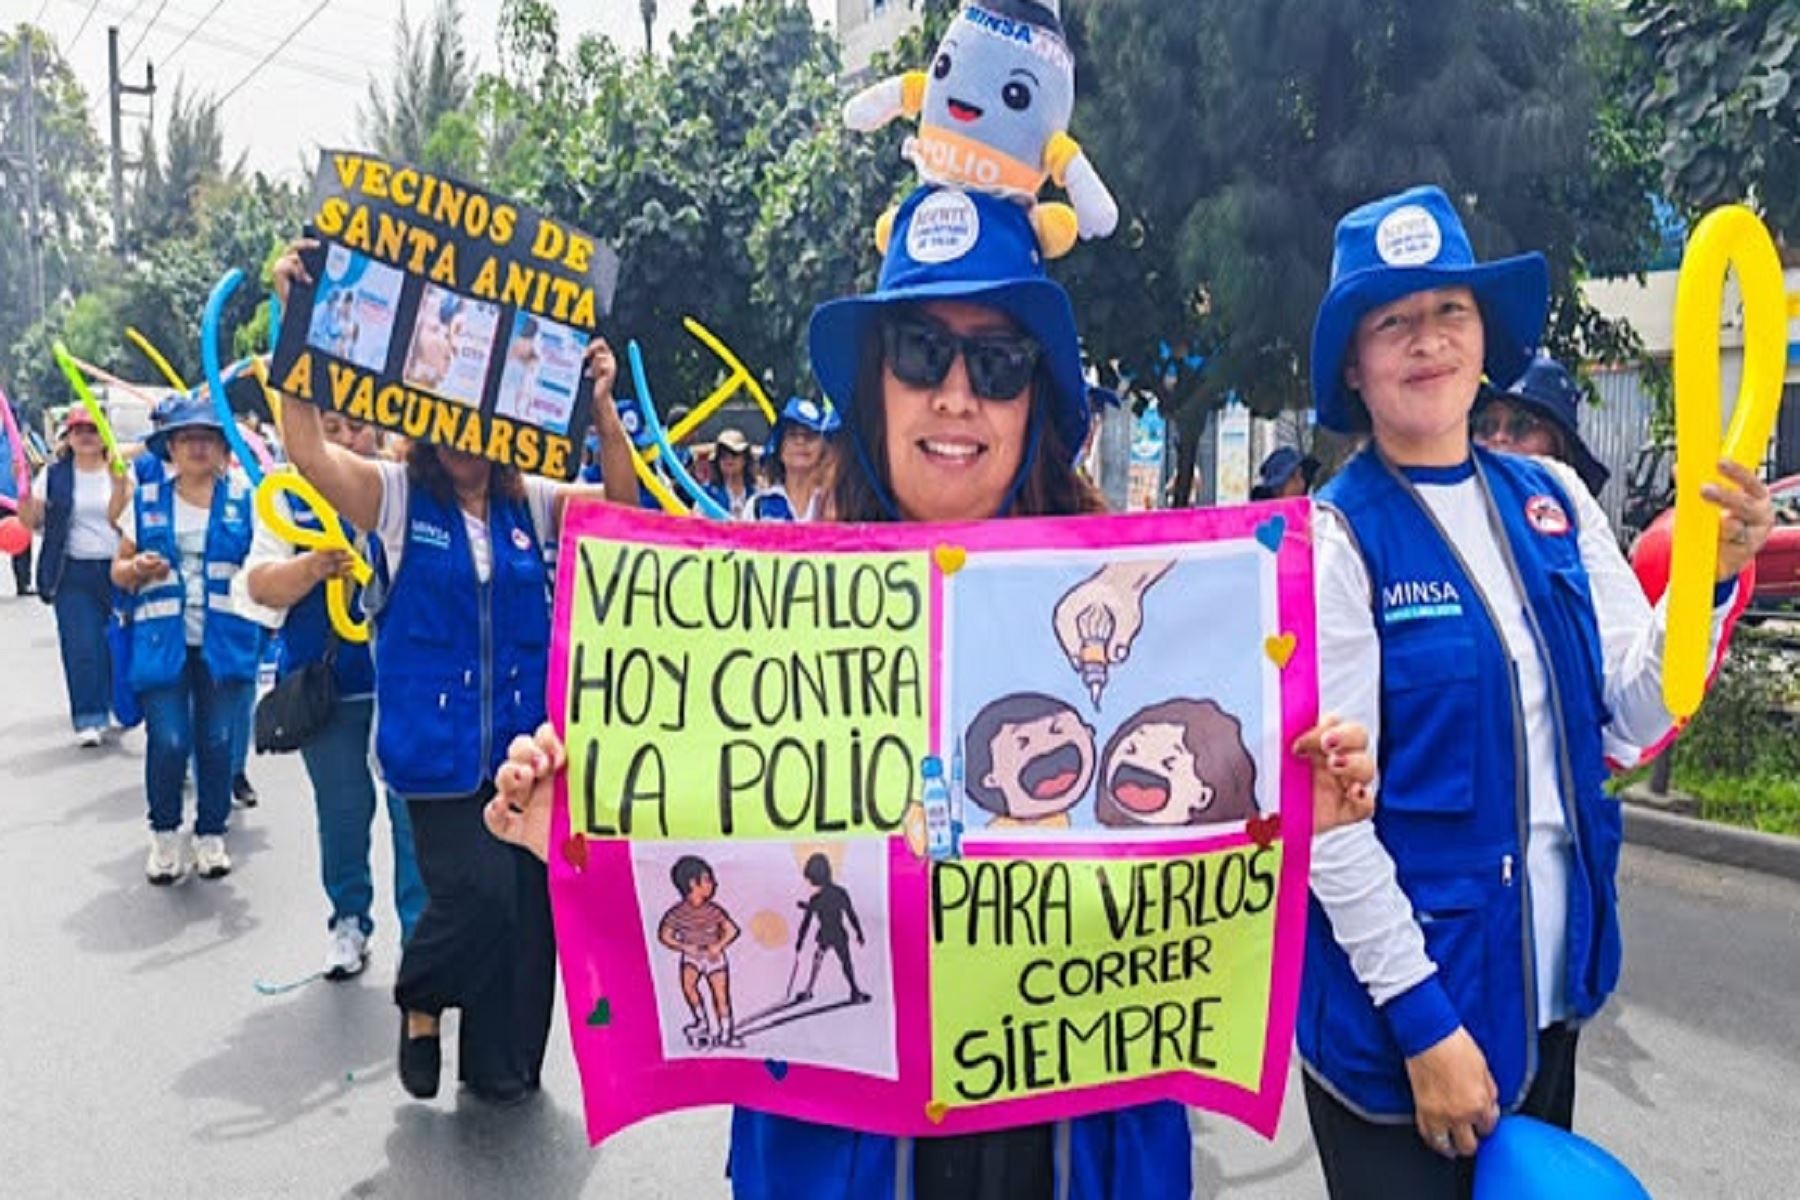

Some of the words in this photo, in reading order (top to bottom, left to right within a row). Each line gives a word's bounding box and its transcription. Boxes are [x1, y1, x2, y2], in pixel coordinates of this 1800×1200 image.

[963, 6, 1033, 45] MINSA
[334, 156, 517, 244] VECINOS
[531, 219, 596, 273] DE
[315, 197, 457, 285] SANTA
[472, 256, 597, 328] ANITA
[283, 352, 313, 398] A
[328, 363, 573, 479] VACUNARSE
[579, 541, 923, 632] VACÚNALOS
[1381, 580, 1460, 608] MINSA
[570, 642, 690, 732] HOY
[711, 645, 923, 731] CONTRA
[583, 738, 669, 837] LA
[931, 859, 1073, 946] PARA
[1095, 845, 1276, 941] VERLOS
[1018, 934, 1213, 1006] CORRER
